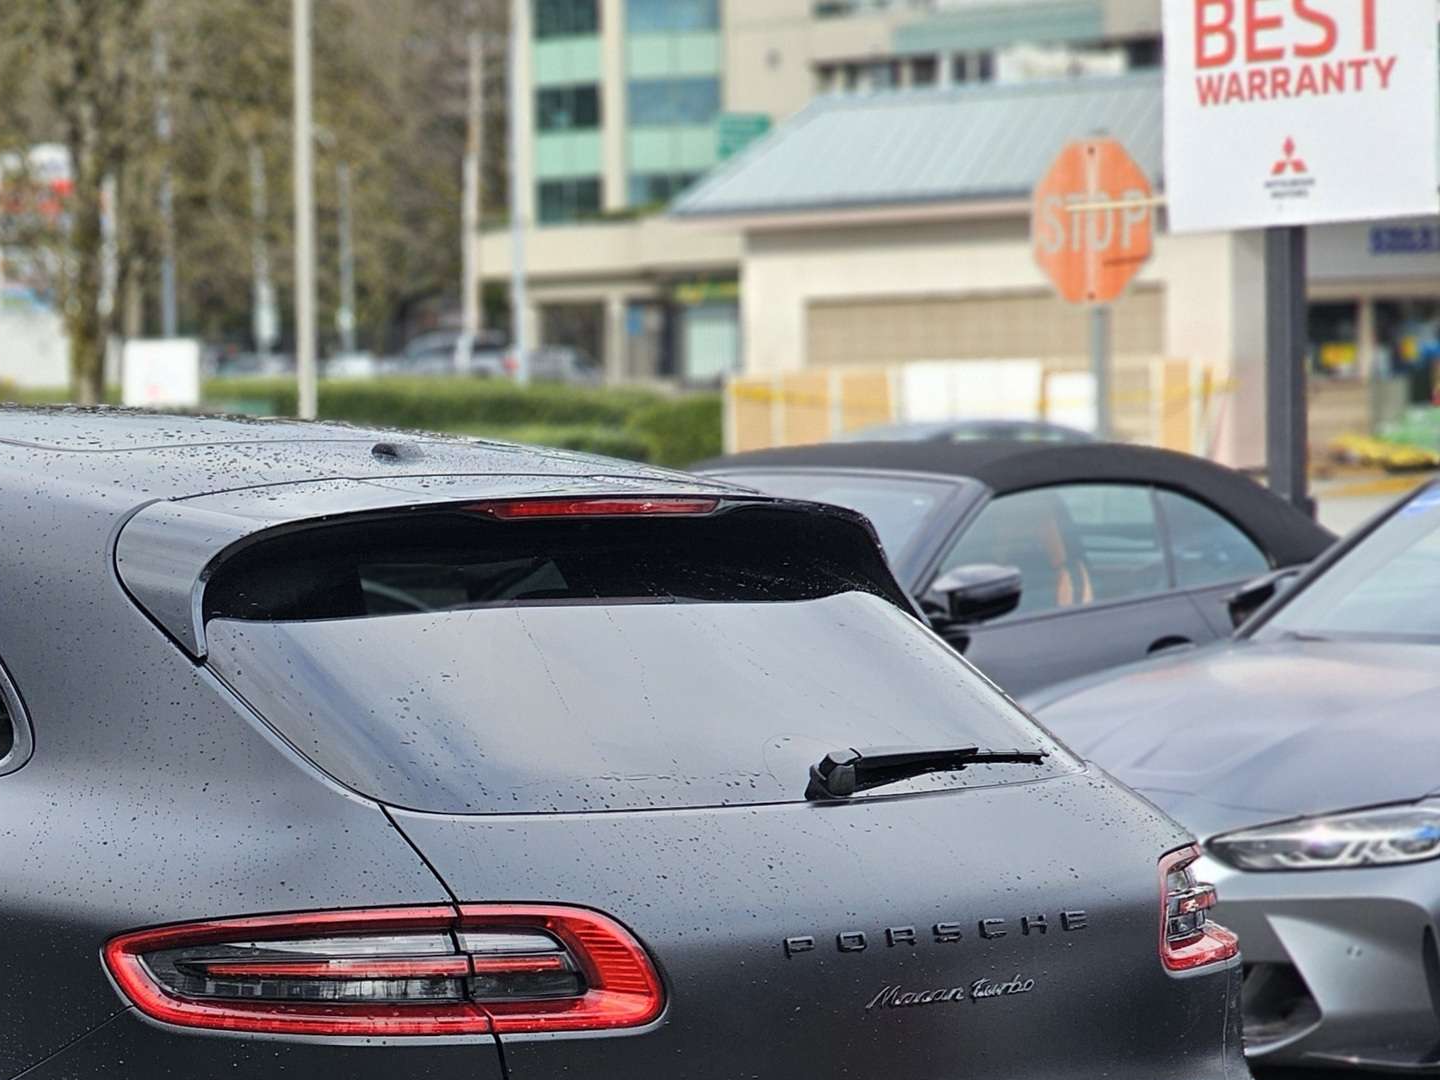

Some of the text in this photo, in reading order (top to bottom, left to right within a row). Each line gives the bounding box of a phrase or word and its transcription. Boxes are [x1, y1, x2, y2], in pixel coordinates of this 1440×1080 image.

[1195, 56, 1398, 107] WARRANTY
[1039, 189, 1147, 254] STOP
[783, 910, 1088, 959] PORSCHE
[865, 984, 964, 1010] Macan
